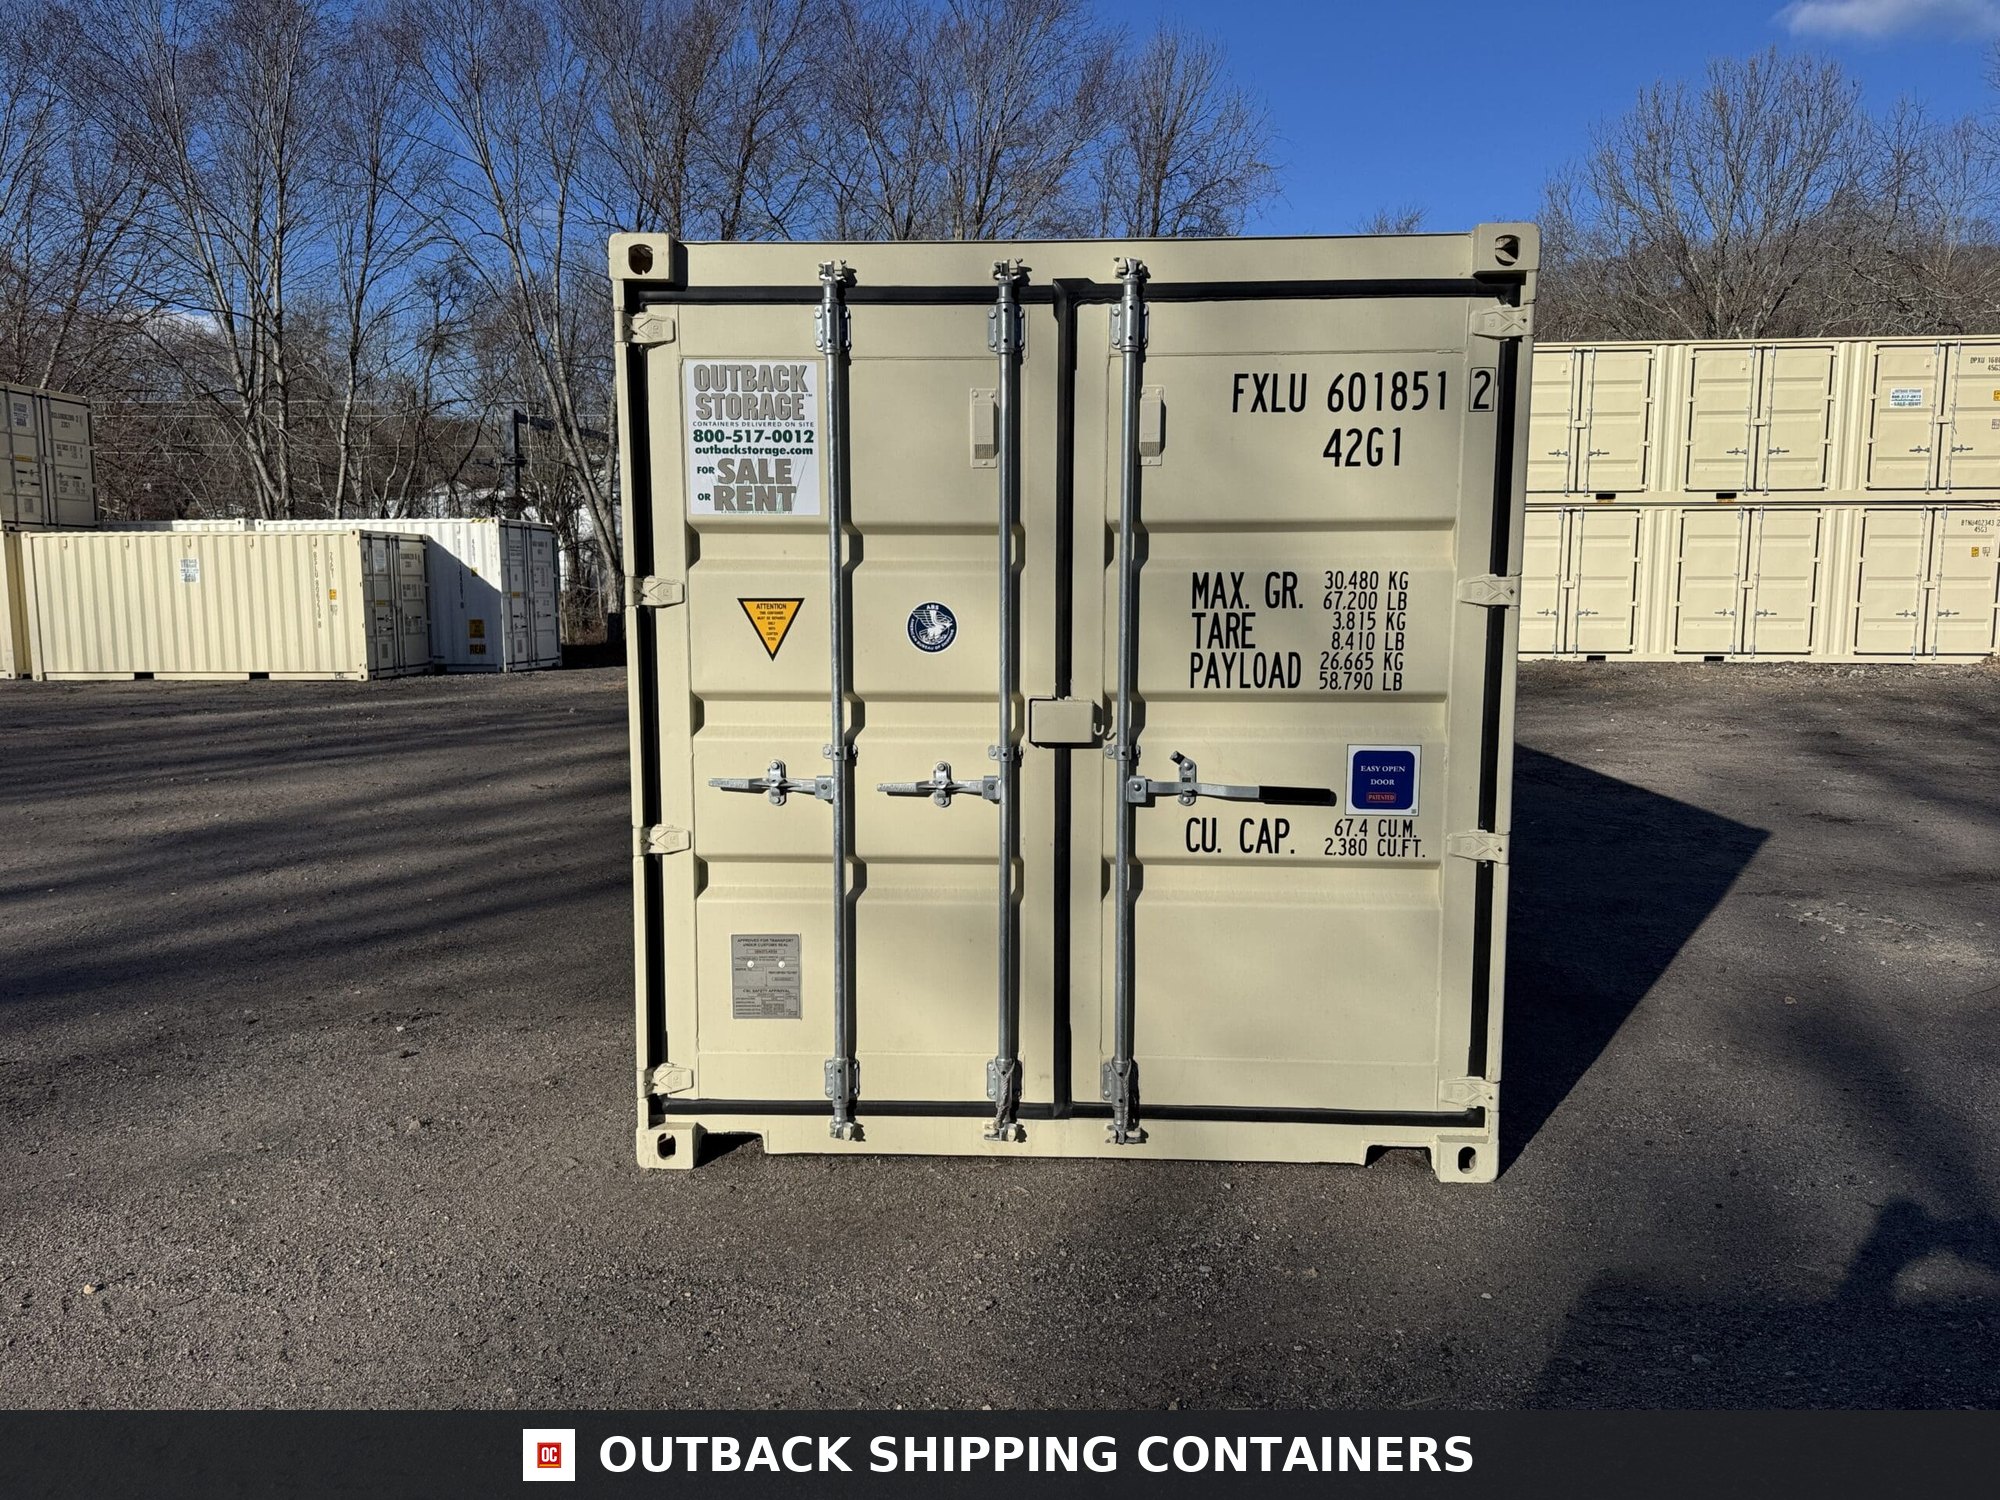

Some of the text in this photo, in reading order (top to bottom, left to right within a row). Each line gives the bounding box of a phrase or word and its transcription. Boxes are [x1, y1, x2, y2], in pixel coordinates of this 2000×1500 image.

[693, 364, 809, 392] OUTBACK
[1232, 369, 1492, 412] FXLU 601851 2
[695, 393, 805, 420] STORAGE
[693, 429, 814, 443] 800-517-0012
[1322, 427, 1402, 467] 42G1
[695, 444, 813, 456] outbackstorage.com
[697, 458, 792, 484] FOR SALE
[697, 486, 797, 511] OR RENT
[1192, 571, 1304, 610] MAX. GR.
[1324, 571, 1409, 590] 30,480 KG
[1323, 591, 1407, 610] 67,200 LB
[1191, 612, 1256, 649] TARE
[1332, 611, 1406, 631] 3,815 KG
[1331, 631, 1404, 651] 8,410 LB
[1190, 652, 1302, 689] PAYLOAD
[1320, 651, 1404, 671] 26,665 KG
[1319, 671, 1402, 691] 58,790 LB
[1185, 818, 1295, 855] CU. CAP.
[1334, 818, 1417, 838] 67.4 CU.M.
[1324, 838, 1425, 857] 2,380 CU.FT.
